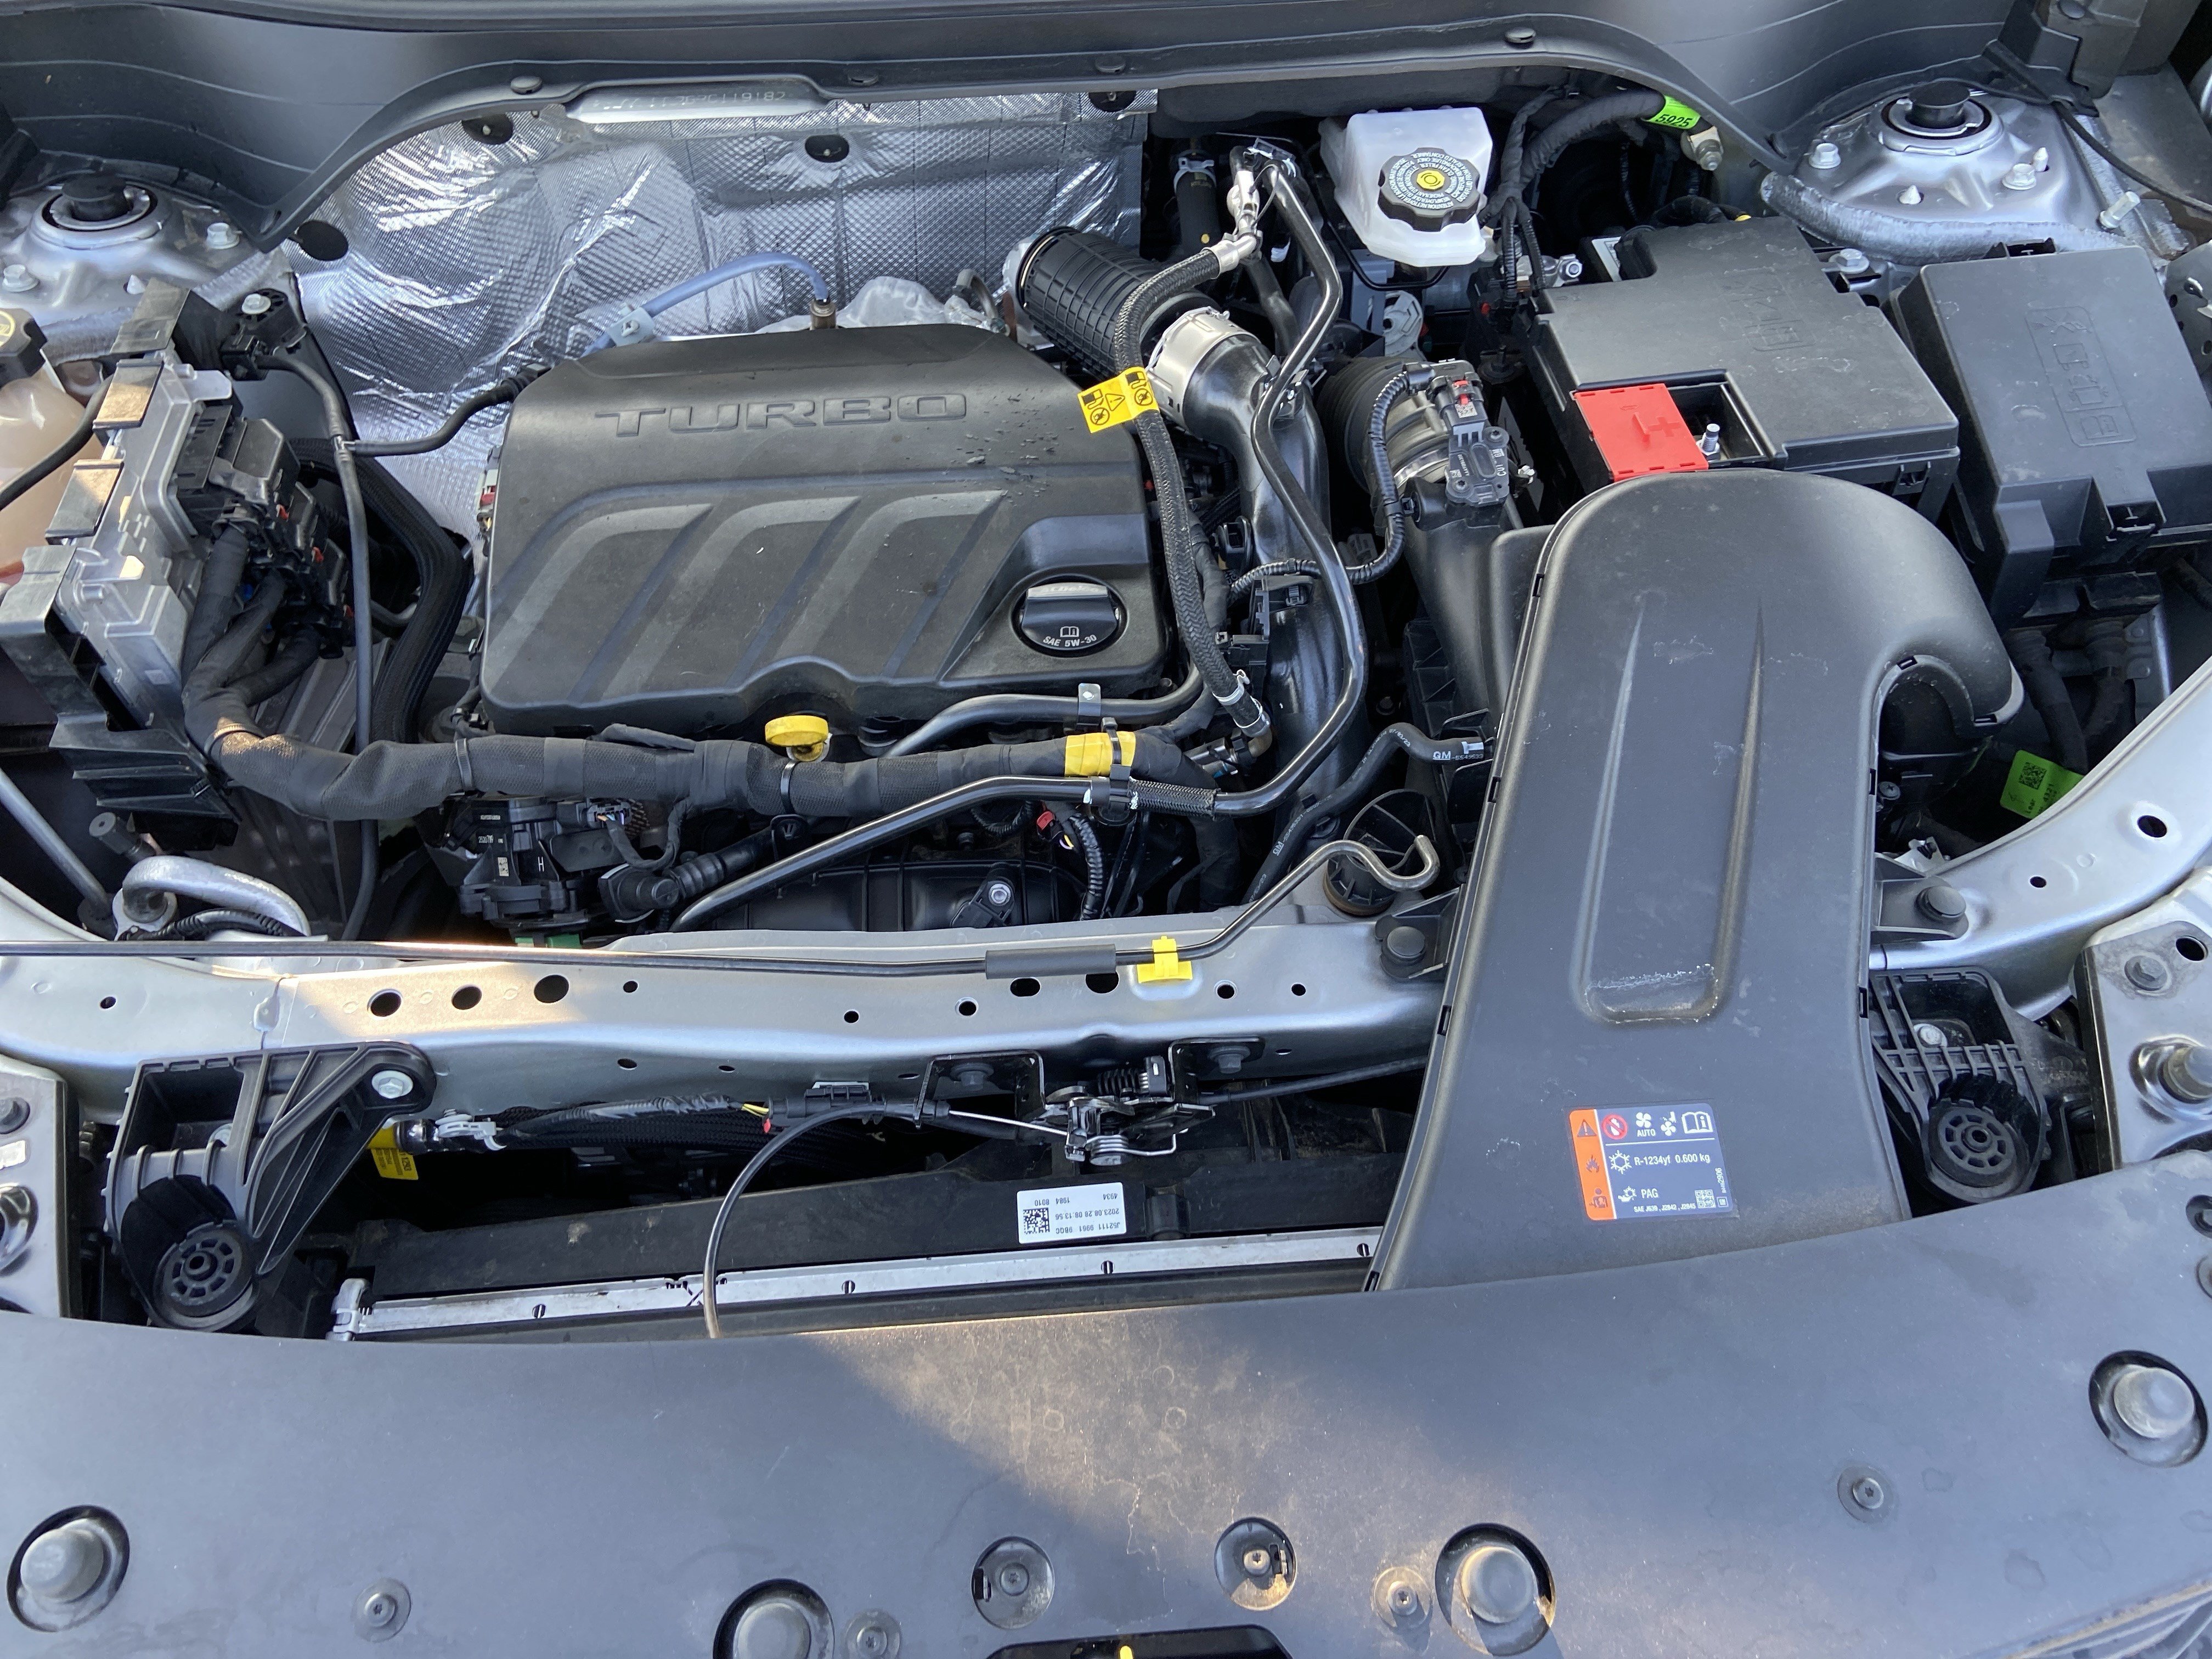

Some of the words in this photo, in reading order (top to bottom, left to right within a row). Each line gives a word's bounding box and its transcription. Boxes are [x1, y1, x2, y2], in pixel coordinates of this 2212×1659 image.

[595, 393, 967, 437] TURBO
[1042, 636, 1062, 647] SAE
[1064, 634, 1098, 647] 5W-30
[538, 856, 545, 872] H
[1637, 1128, 1656, 1137] AUTO
[1634, 1154, 1671, 1166] R-1234yf
[1675, 1153, 1698, 1164] 0.600
[1700, 1153, 1711, 1164] kg
[1641, 1188, 1659, 1199] PAG
[1034, 1198, 1050, 1206] 8010
[1084, 1208, 1120, 1217] 2023.08.28
[1098, 1222, 1120, 1231] J52111
